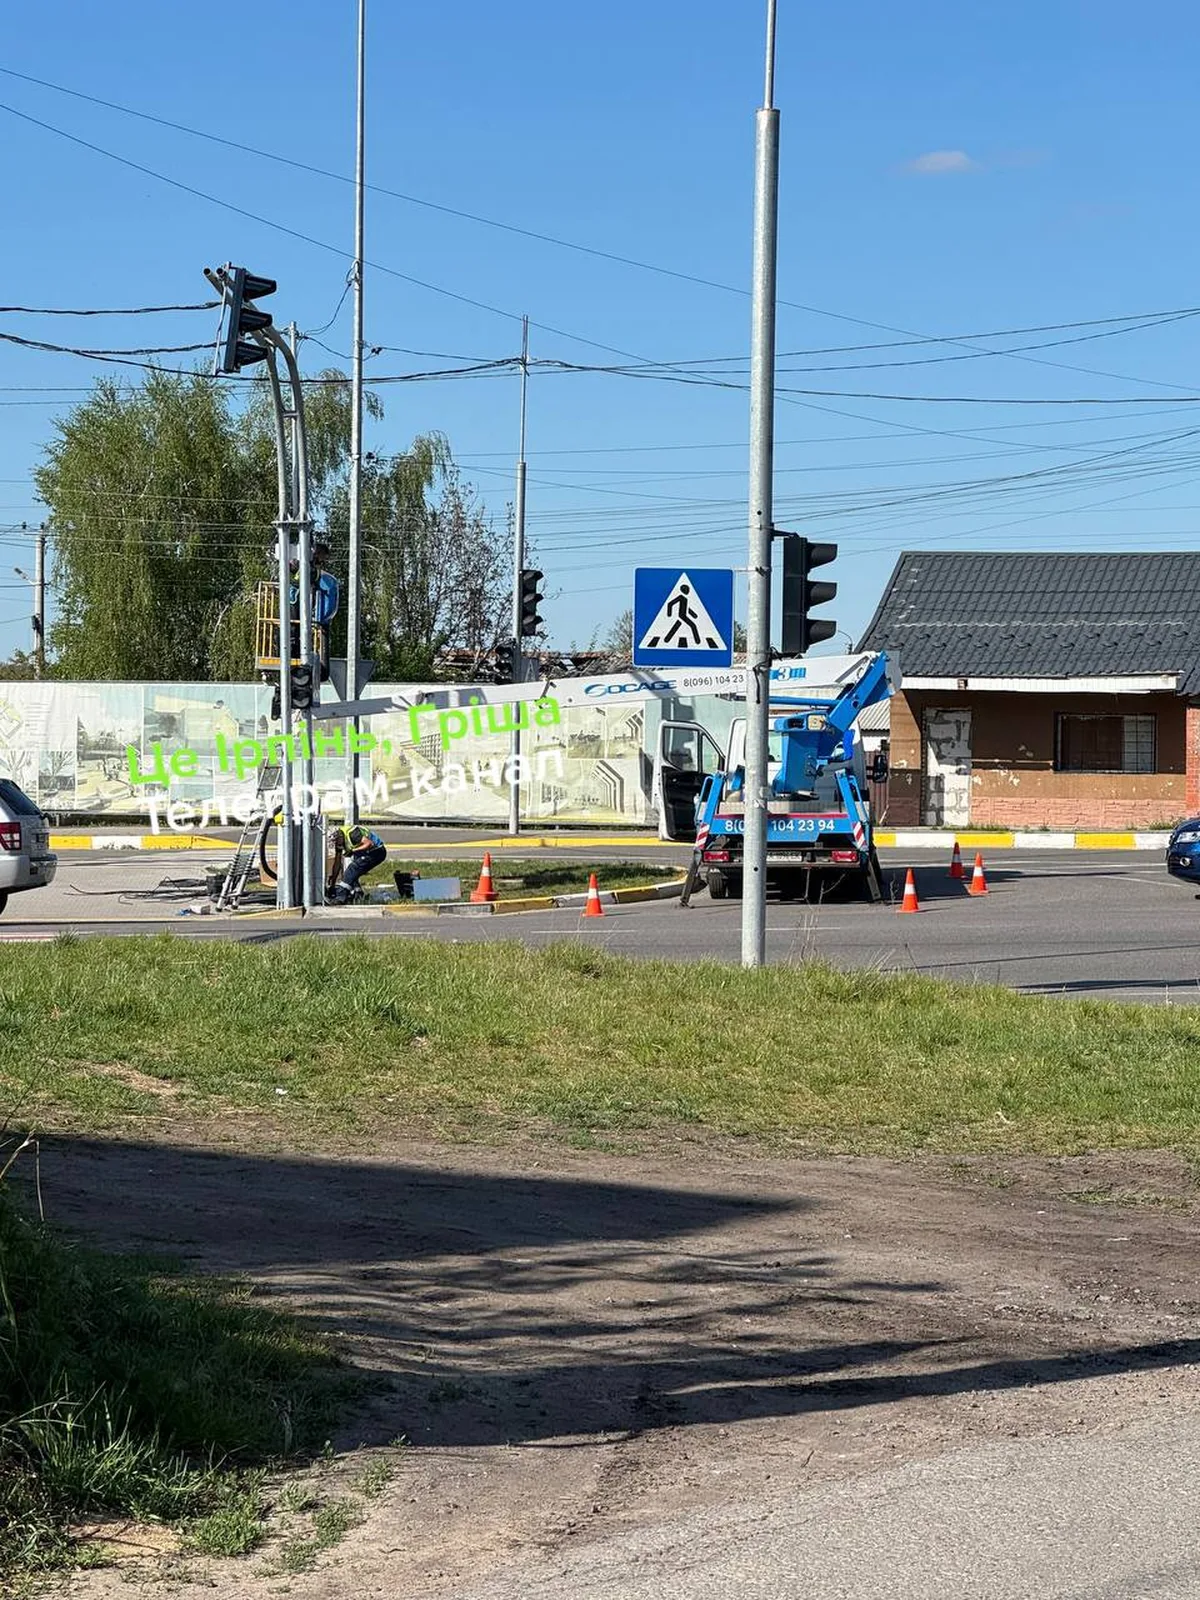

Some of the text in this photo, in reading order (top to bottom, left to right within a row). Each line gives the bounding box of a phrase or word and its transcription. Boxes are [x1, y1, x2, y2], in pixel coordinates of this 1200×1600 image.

[683, 674, 745, 688] 8(096) 104 23
[771, 819, 794, 832] 104
[798, 819, 815, 832] 23
[818, 819, 835, 832] 94
